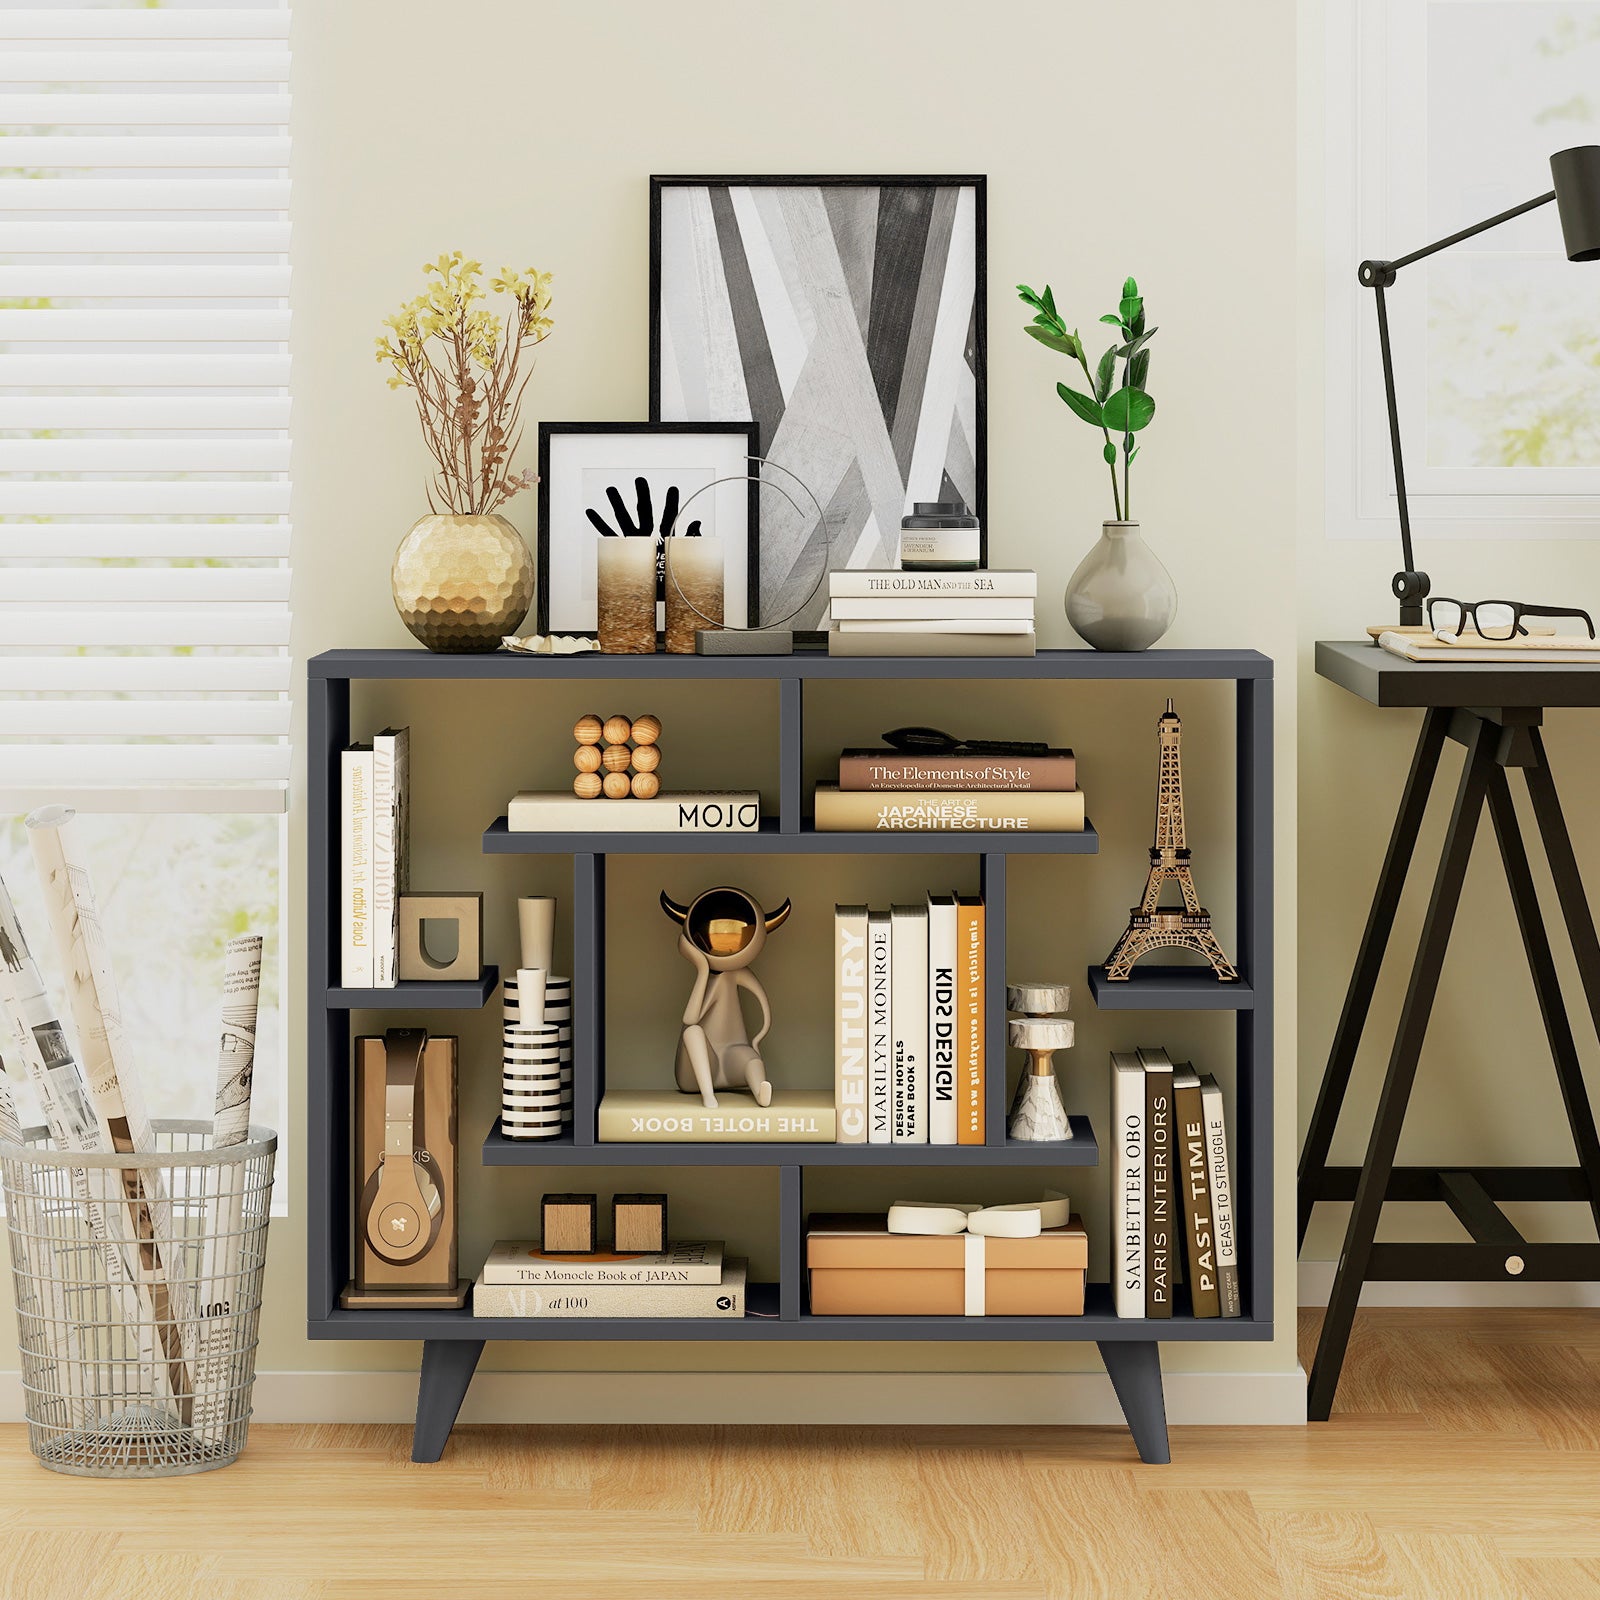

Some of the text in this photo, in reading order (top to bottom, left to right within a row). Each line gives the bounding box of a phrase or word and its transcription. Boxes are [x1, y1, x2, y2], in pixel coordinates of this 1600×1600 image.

[868, 578, 994, 590] THE OLD MAN AND THE SEA
[870, 766, 1031, 783] The Elements of Style
[679, 803, 758, 828] MOJO
[876, 818, 1029, 829] ARCHITECTURE
[877, 806, 978, 818] JAPANESE
[841, 927, 864, 1137] CENTURY
[874, 933, 887, 1132] MARILYN MONROE
[896, 1040, 904, 1137] DESIGN HOTELS
[907, 1054, 915, 1138] YEAR BOOK 9
[631, 1117, 819, 1133] THE HOTEL BOOK
[1125, 1115, 1141, 1290] SANBETTER OBO
[1154, 1096, 1167, 1304] PARIS INTERIORS
[1186, 1121, 1215, 1292] PAST TIME
[1210, 1120, 1233, 1258] CEASE TO STRUGGLE
[517, 1269, 690, 1283] The Monocle Book of JAPAN
[548, 1297, 562, 1309] at
[564, 1297, 588, 1310] 100
